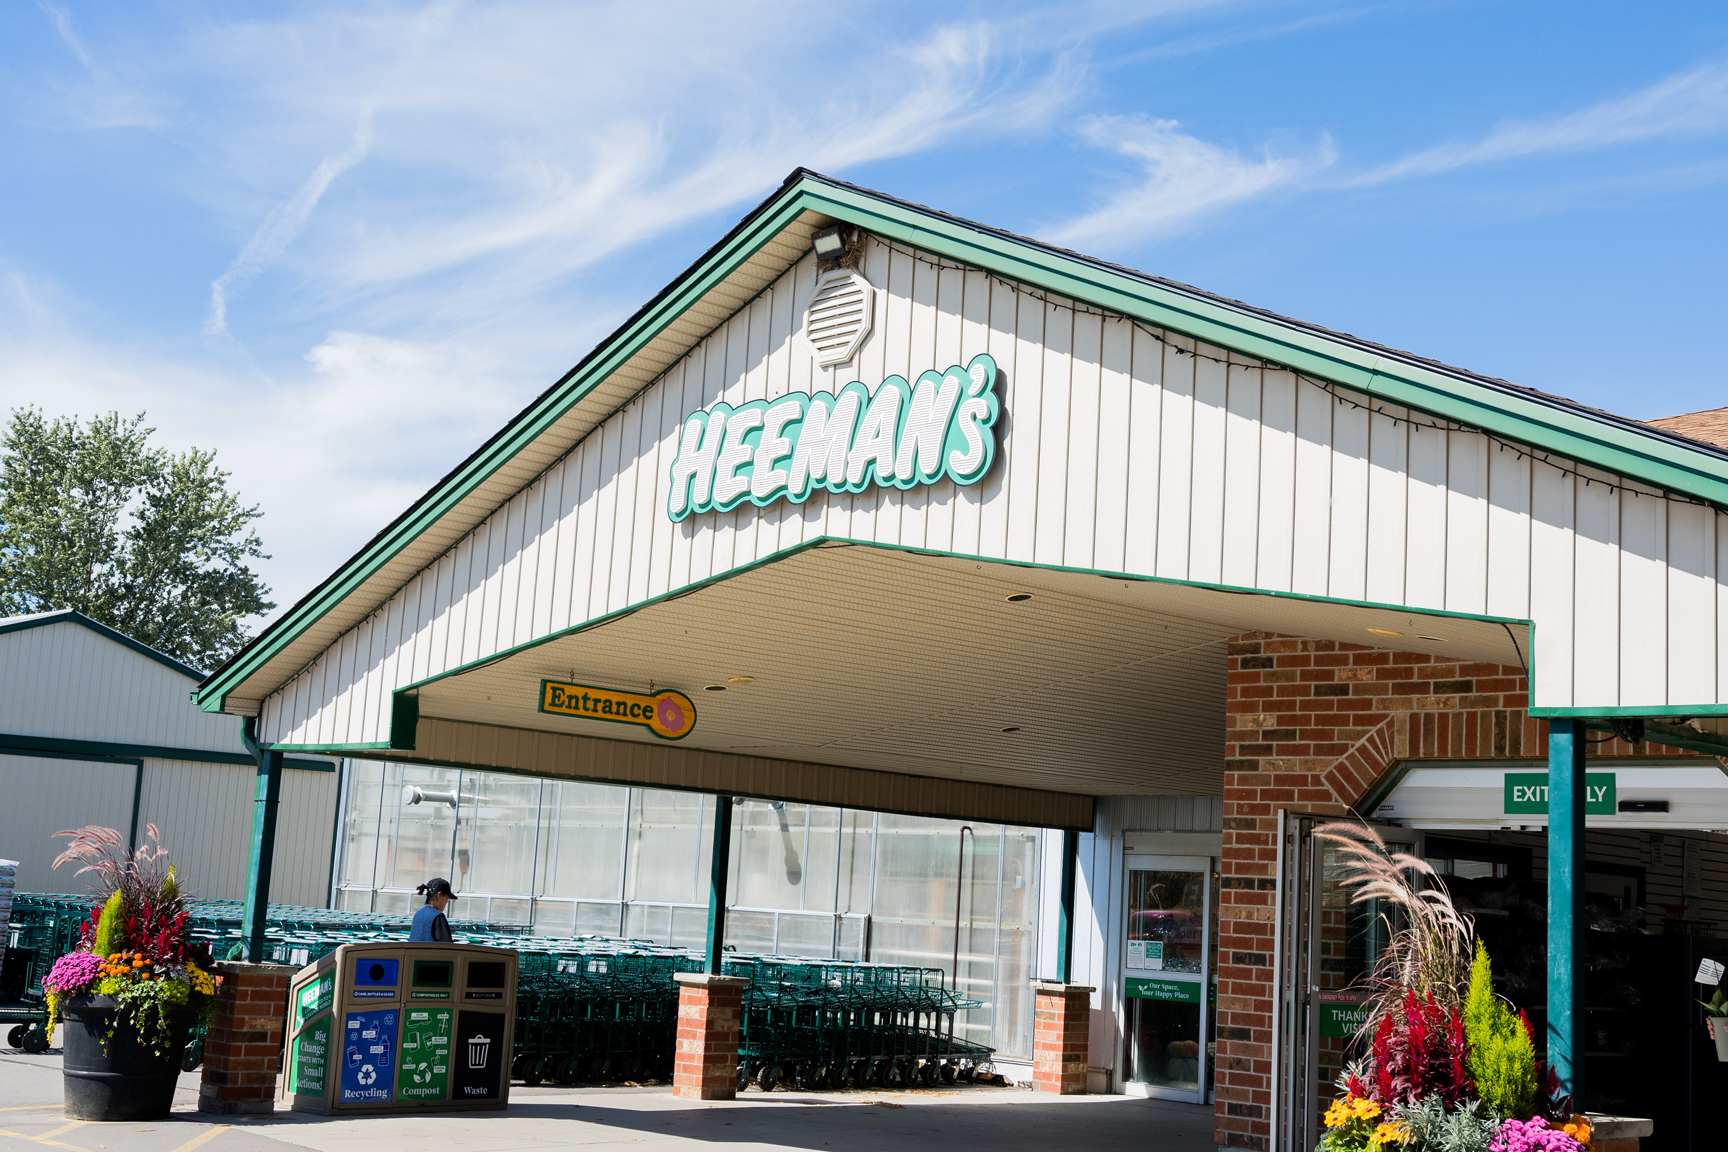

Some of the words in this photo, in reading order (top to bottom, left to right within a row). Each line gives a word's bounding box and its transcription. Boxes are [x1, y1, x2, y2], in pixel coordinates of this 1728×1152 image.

[548, 686, 654, 720] Entrance
[1513, 786, 1549, 802] EXIT
[1161, 983, 1179, 991] Space,
[1155, 990, 1173, 999] Happy
[1174, 991, 1190, 999] Place
[314, 1030, 327, 1044] Big
[300, 1042, 325, 1056] Change
[296, 1055, 311, 1063] STARTS
[311, 1057, 324, 1065] WITH
[303, 1065, 323, 1077] Small
[294, 1078, 323, 1090] Actions!
[344, 1087, 388, 1100] Recycling
[402, 1086, 440, 1097] Compost
[464, 1086, 488, 1095] Waste
